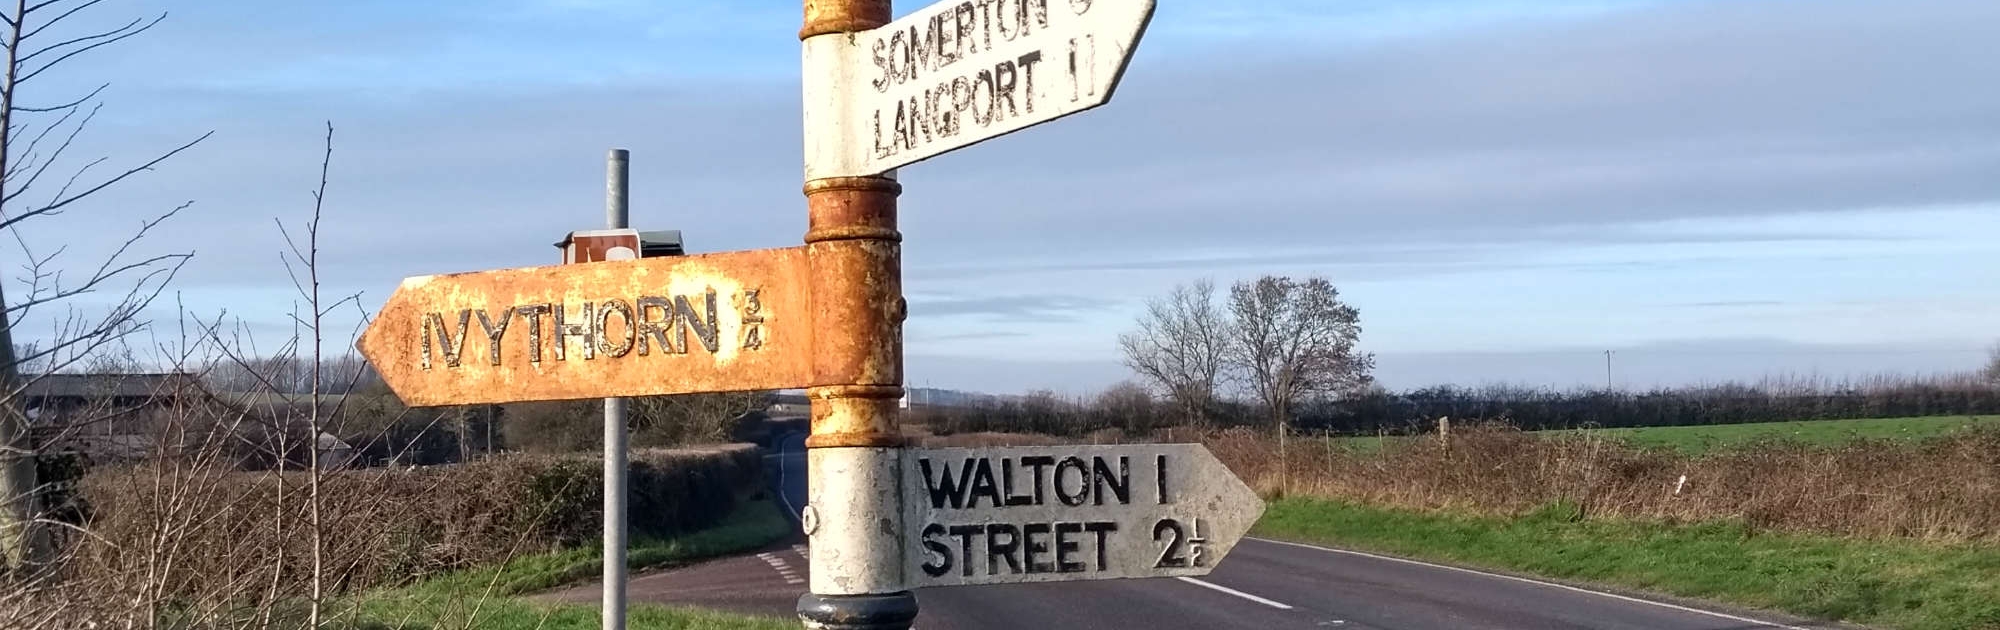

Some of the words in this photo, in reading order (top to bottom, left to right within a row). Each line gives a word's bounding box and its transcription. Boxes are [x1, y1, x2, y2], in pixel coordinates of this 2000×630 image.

[872, 0, 1048, 94] SOMERTON
[873, 50, 1042, 159] LANGPORT
[420, 288, 719, 370] IVYTHORN
[919, 455, 1131, 509] WALTON
[921, 521, 1118, 577] STREET
